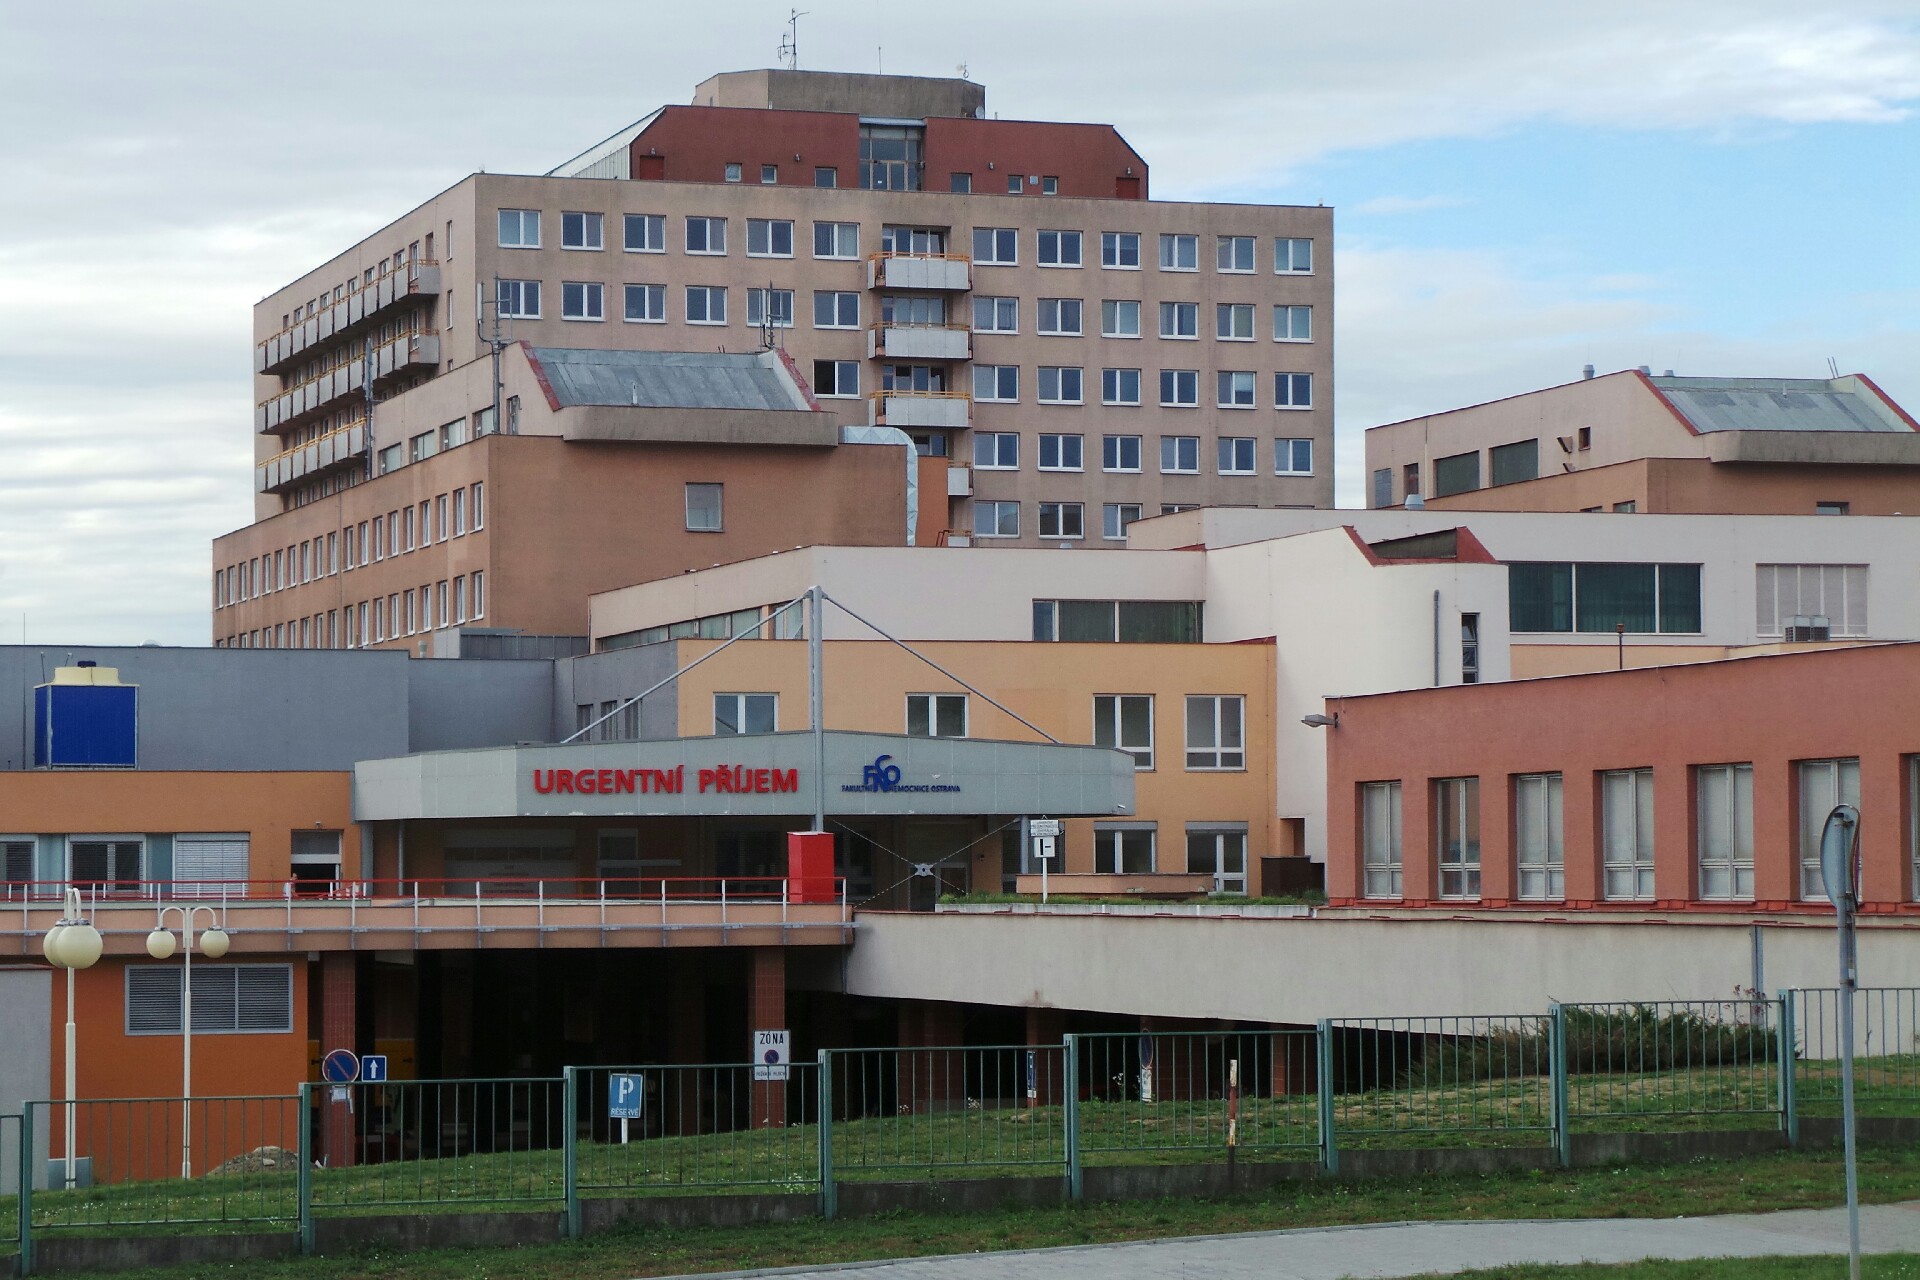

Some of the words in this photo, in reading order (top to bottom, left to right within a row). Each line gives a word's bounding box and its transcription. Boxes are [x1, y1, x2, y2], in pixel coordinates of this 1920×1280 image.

[534, 765, 685, 794] URGENTNÍ
[698, 765, 798, 793] PŘÍJEM
[931, 784, 960, 793] OSTRAVA
[760, 1032, 784, 1045] ZÓNA
[618, 1077, 634, 1104] P
